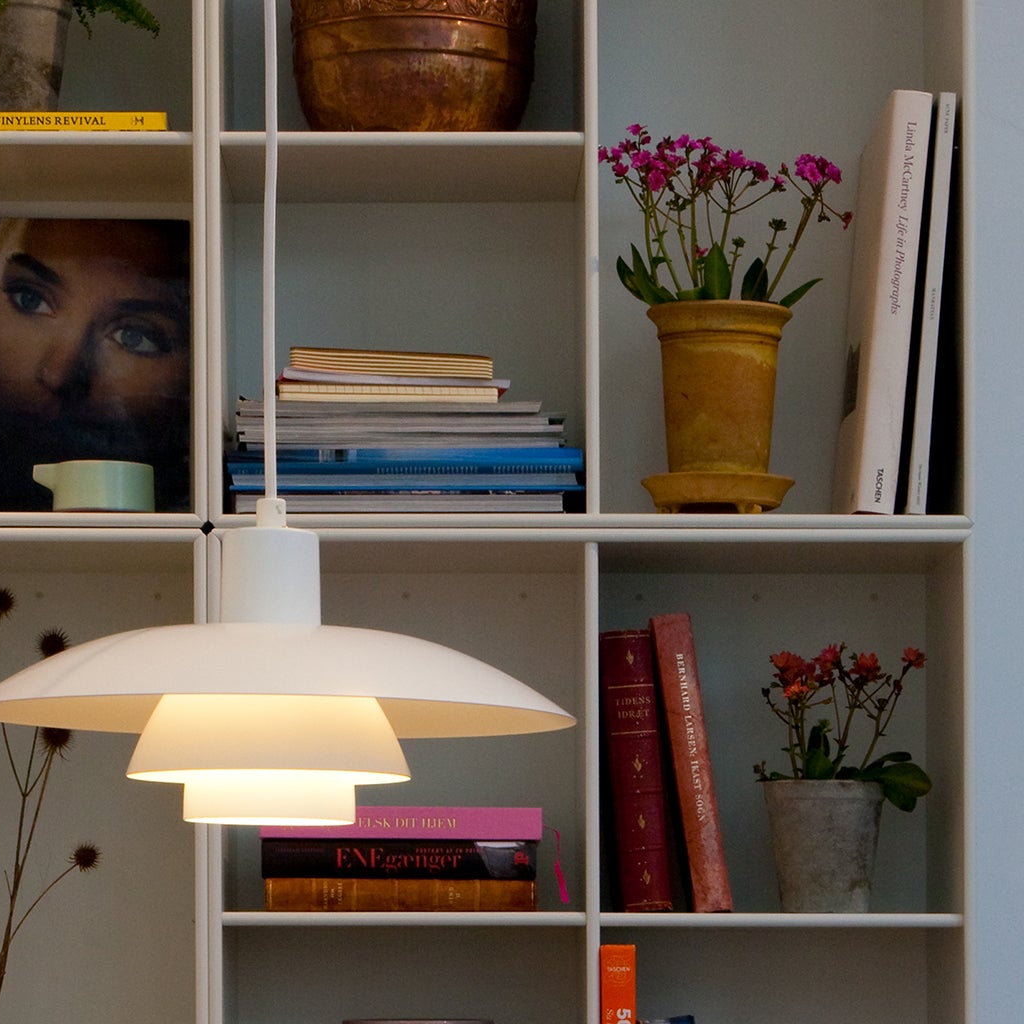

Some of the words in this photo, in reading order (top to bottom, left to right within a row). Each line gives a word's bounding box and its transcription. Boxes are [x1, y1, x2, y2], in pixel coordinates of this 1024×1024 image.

[54, 115, 107, 126] REVIVAL
[905, 121, 918, 152] Linda
[899, 153, 916, 212] McCartney
[897, 215, 910, 237] Life
[896, 238, 906, 250] in
[889, 251, 905, 316] Photographs
[873, 467, 884, 504] TASCHEN
[675, 652, 690, 712] BERNHARD
[615, 696, 651, 706] TIDENS
[358, 817, 391, 828] ELSK
[395, 817, 418, 828] DIT
[421, 817, 457, 829] HJEM
[336, 847, 462, 874] ENEgænger
[606, 1008, 614, 1020] Su
